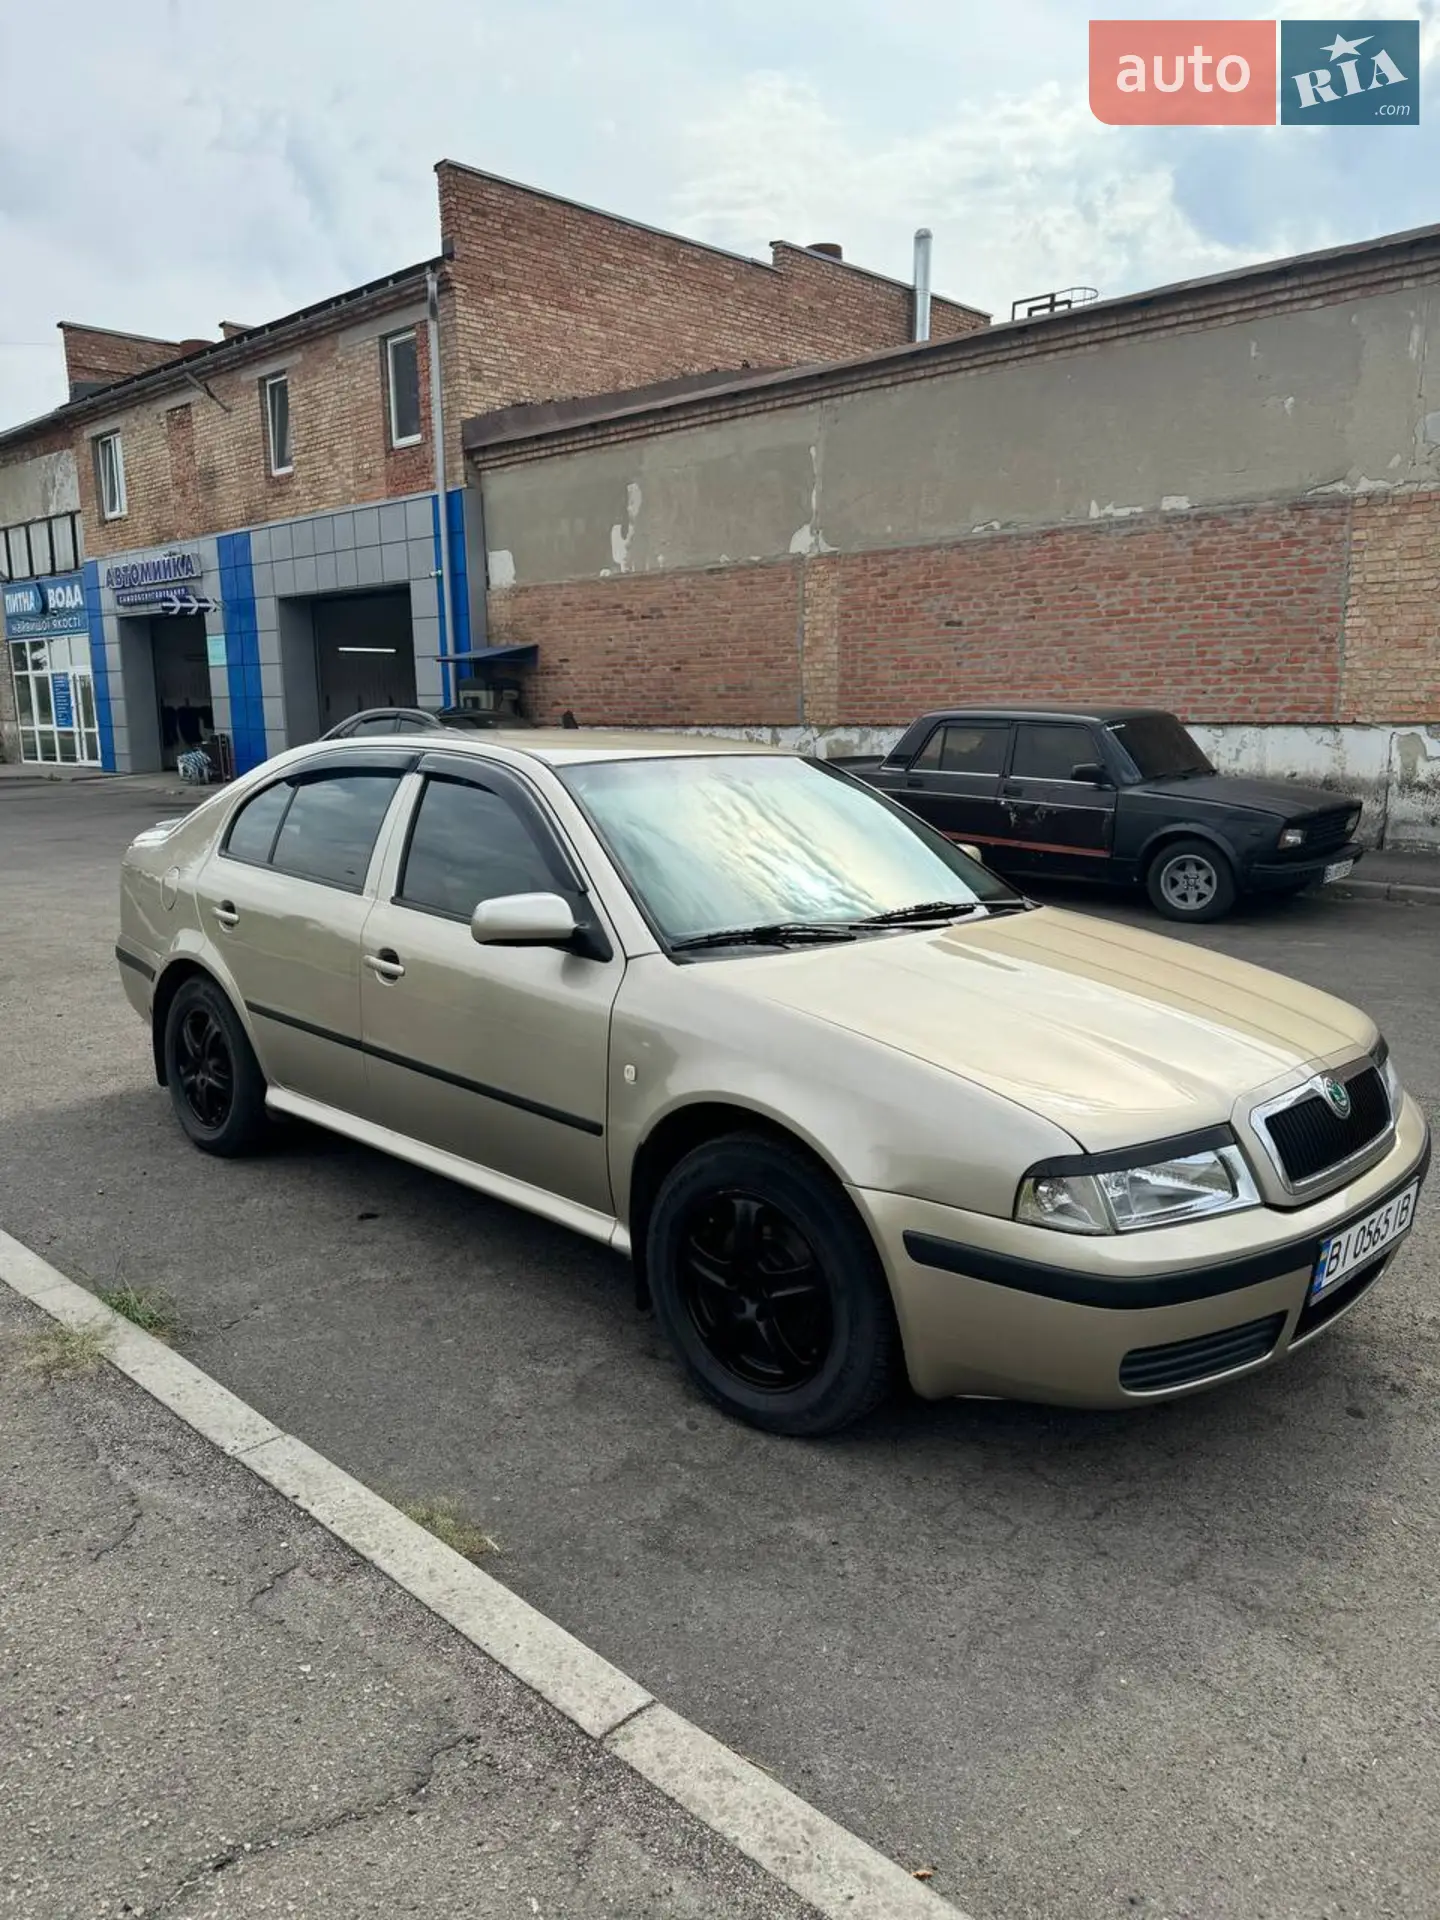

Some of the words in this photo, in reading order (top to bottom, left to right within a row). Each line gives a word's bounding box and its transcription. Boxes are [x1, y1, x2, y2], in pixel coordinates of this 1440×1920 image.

[105, 553, 196, 588] АВТОМИЙКА
[5, 590, 37, 614] ПИТНА
[47, 584, 83, 609] ВОДА
[1326, 1233, 1351, 1277] BI
[1353, 1206, 1393, 1259] 0565
[1393, 1193, 1411, 1233] IB
